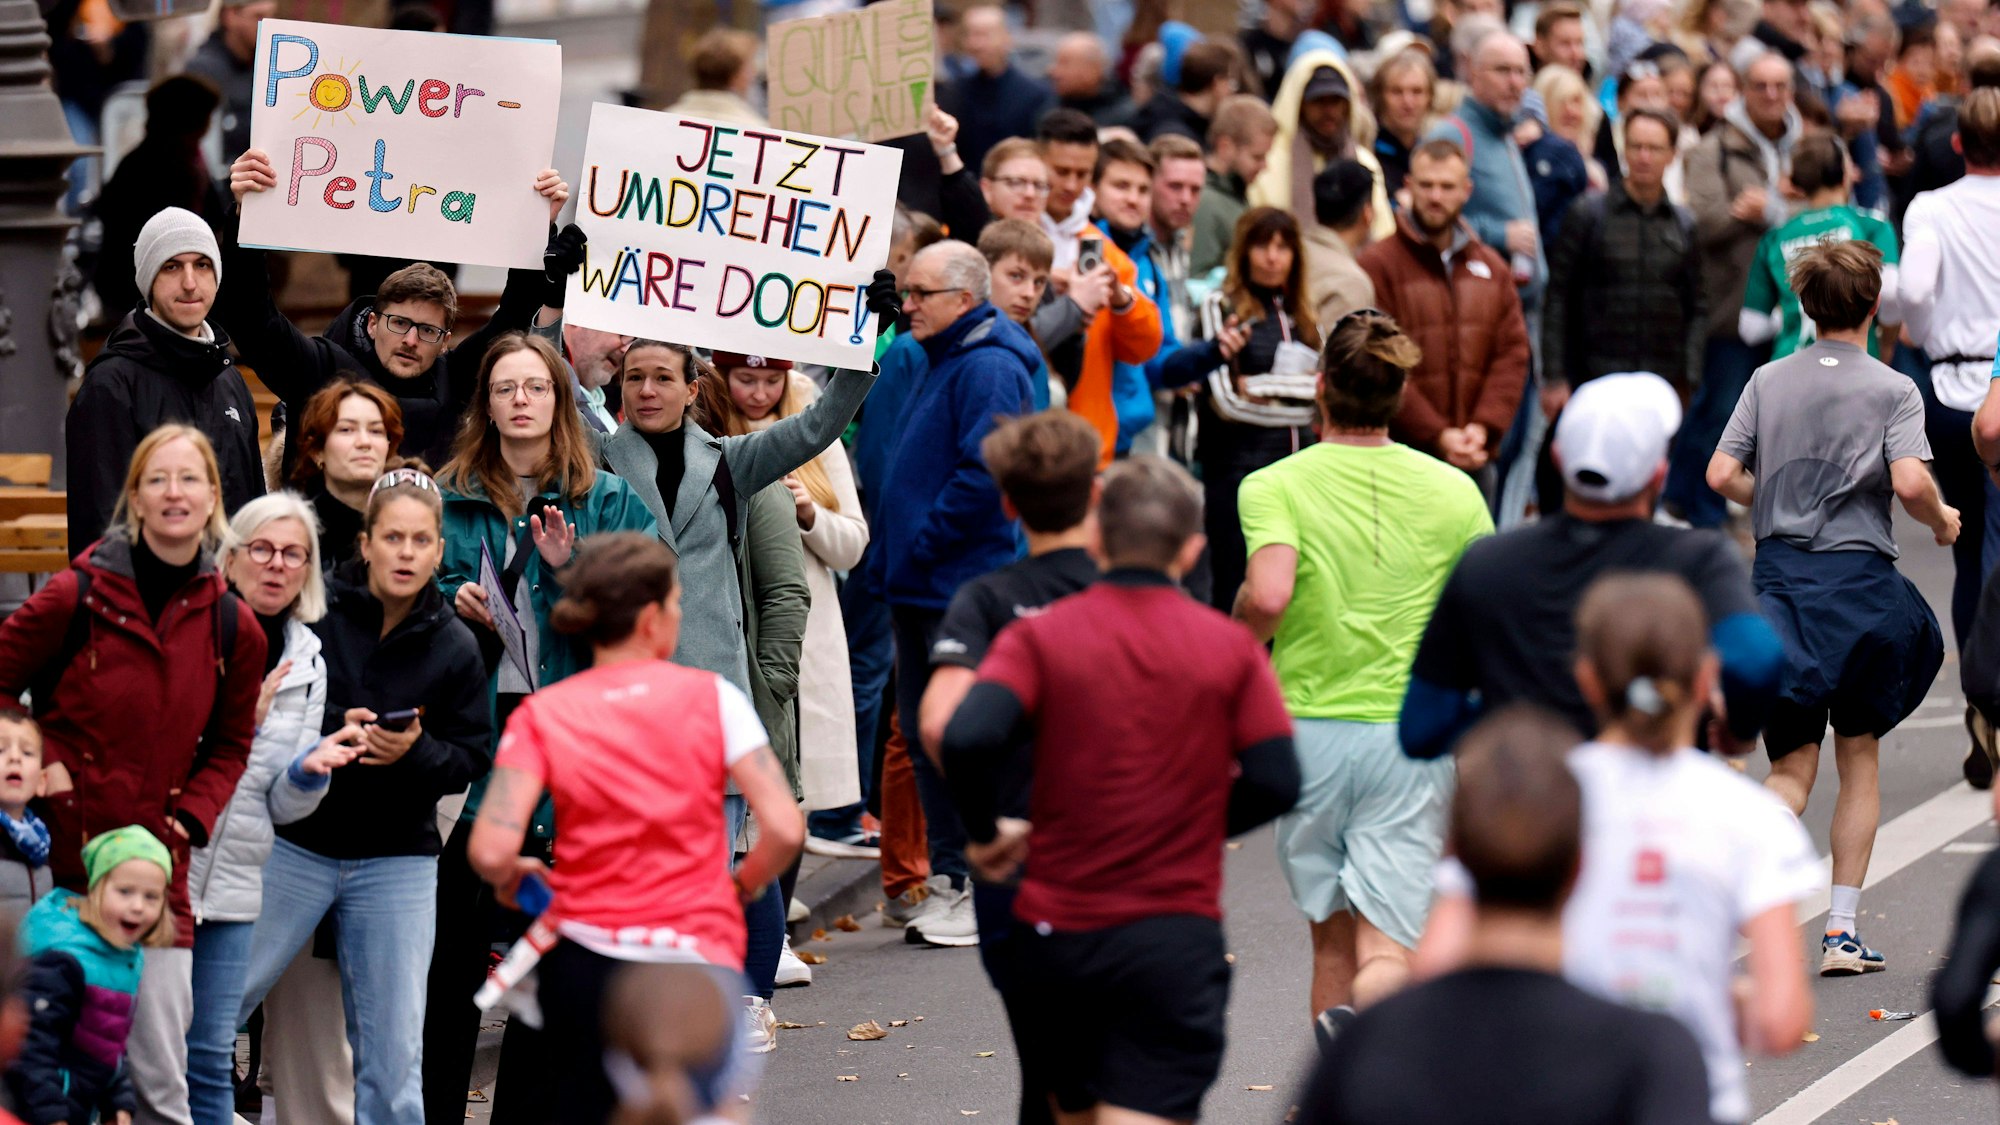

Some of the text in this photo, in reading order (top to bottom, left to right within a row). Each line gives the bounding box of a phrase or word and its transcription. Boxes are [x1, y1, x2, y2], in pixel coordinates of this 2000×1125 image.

[265, 34, 521, 118] Power-
[287, 136, 476, 224] Petra
[676, 120, 865, 196] JETZT
[587, 165, 871, 262] UMDREHEN
[581, 243, 871, 345] WÄRE DOOF!
